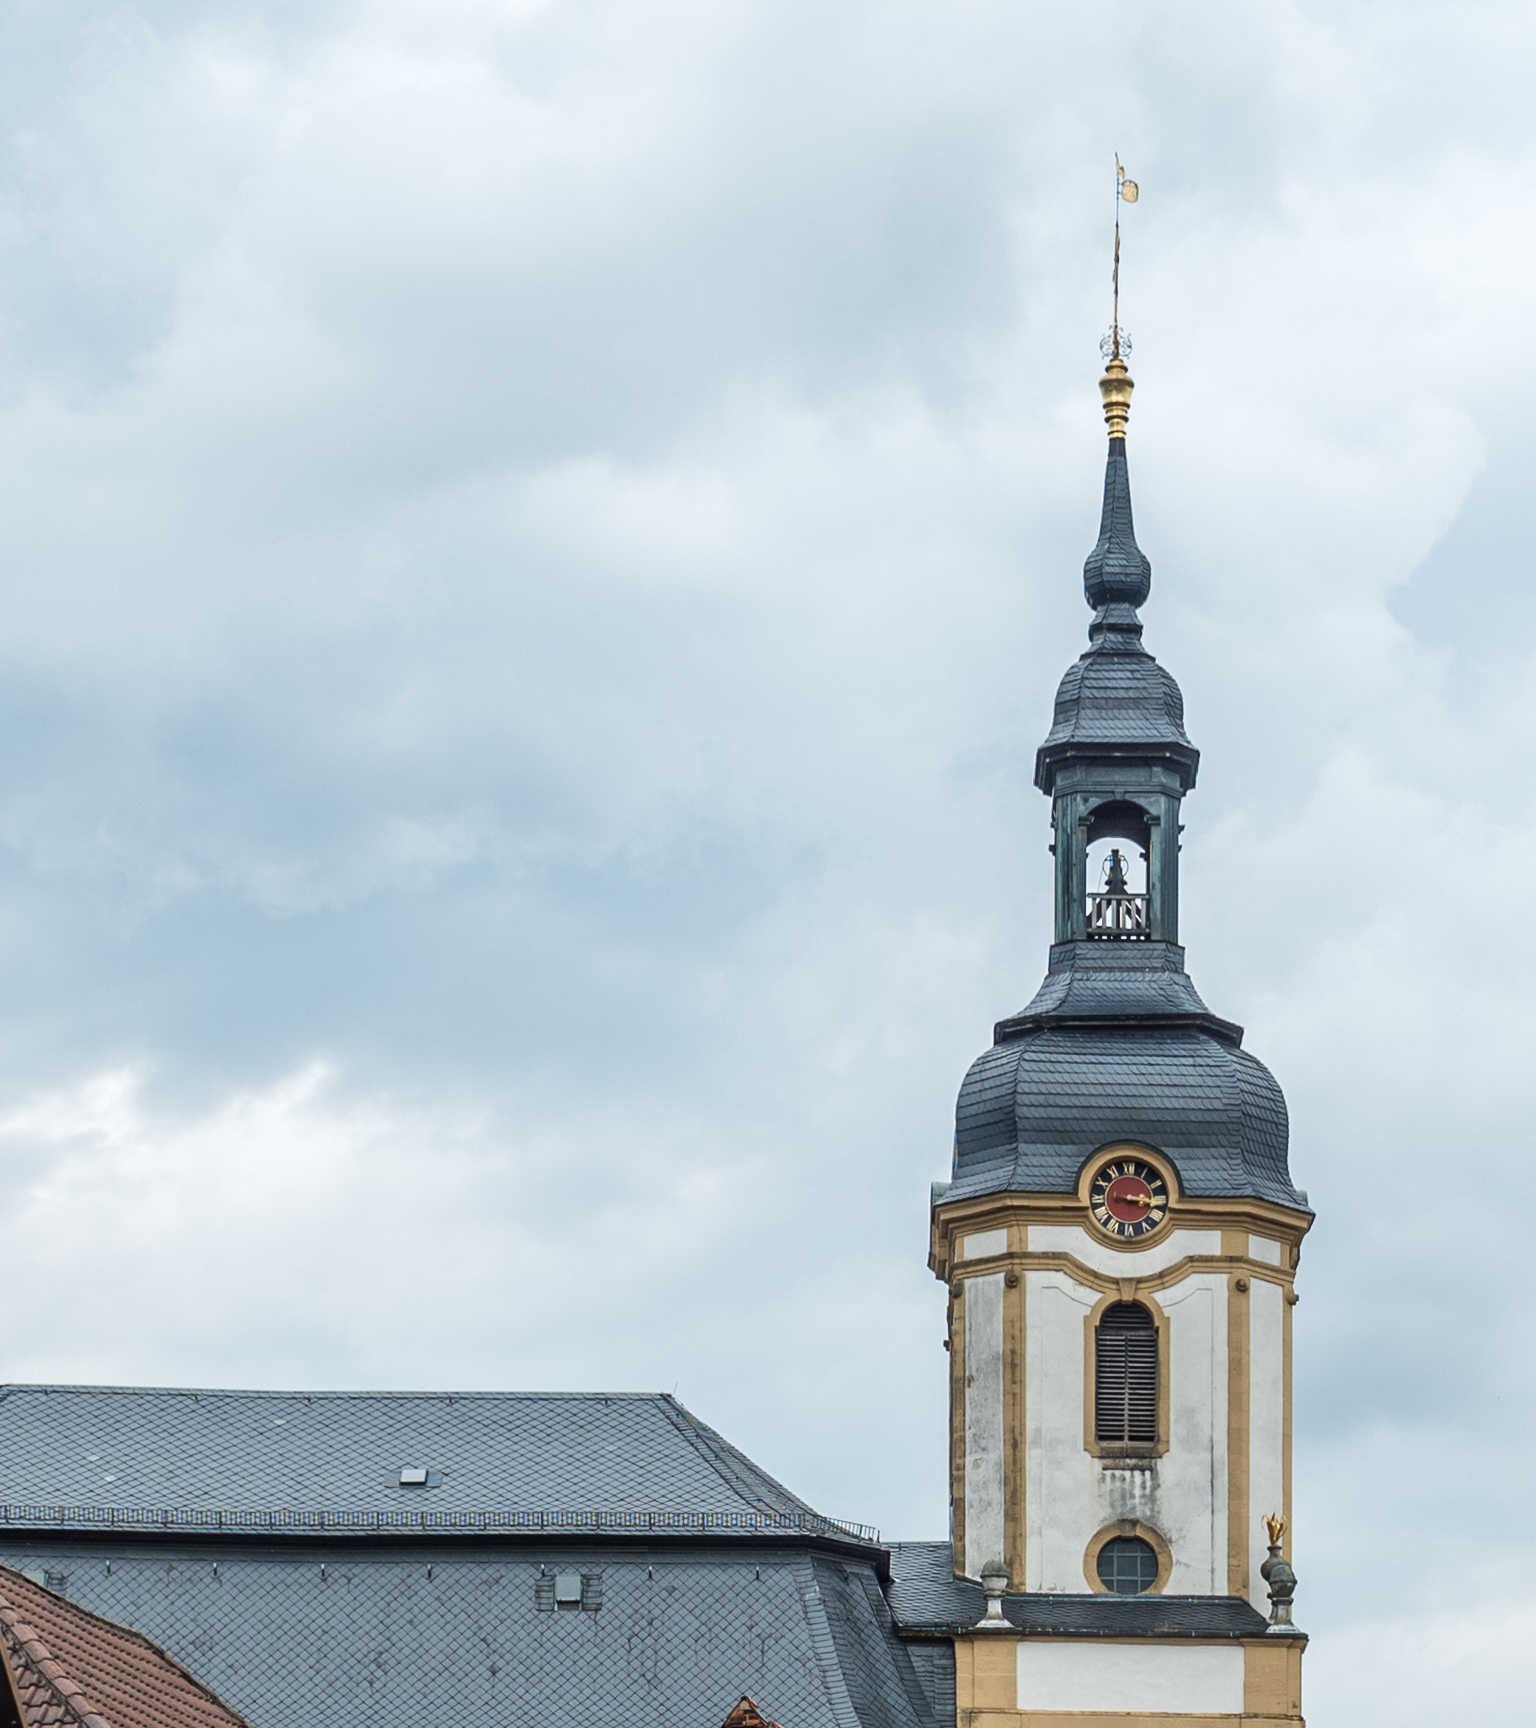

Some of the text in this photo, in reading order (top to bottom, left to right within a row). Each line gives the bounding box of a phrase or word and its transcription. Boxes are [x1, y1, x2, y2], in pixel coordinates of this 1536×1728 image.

[1106, 1165, 1119, 1179] XI
[1122, 1162, 1135, 1175] XII
[1141, 1167, 1148, 1179] I
[1095, 1176, 1109, 1189] X
[1150, 1179, 1162, 1189] II
[1091, 1193, 1104, 1203] IX
[1141, 1221, 1152, 1234] V
